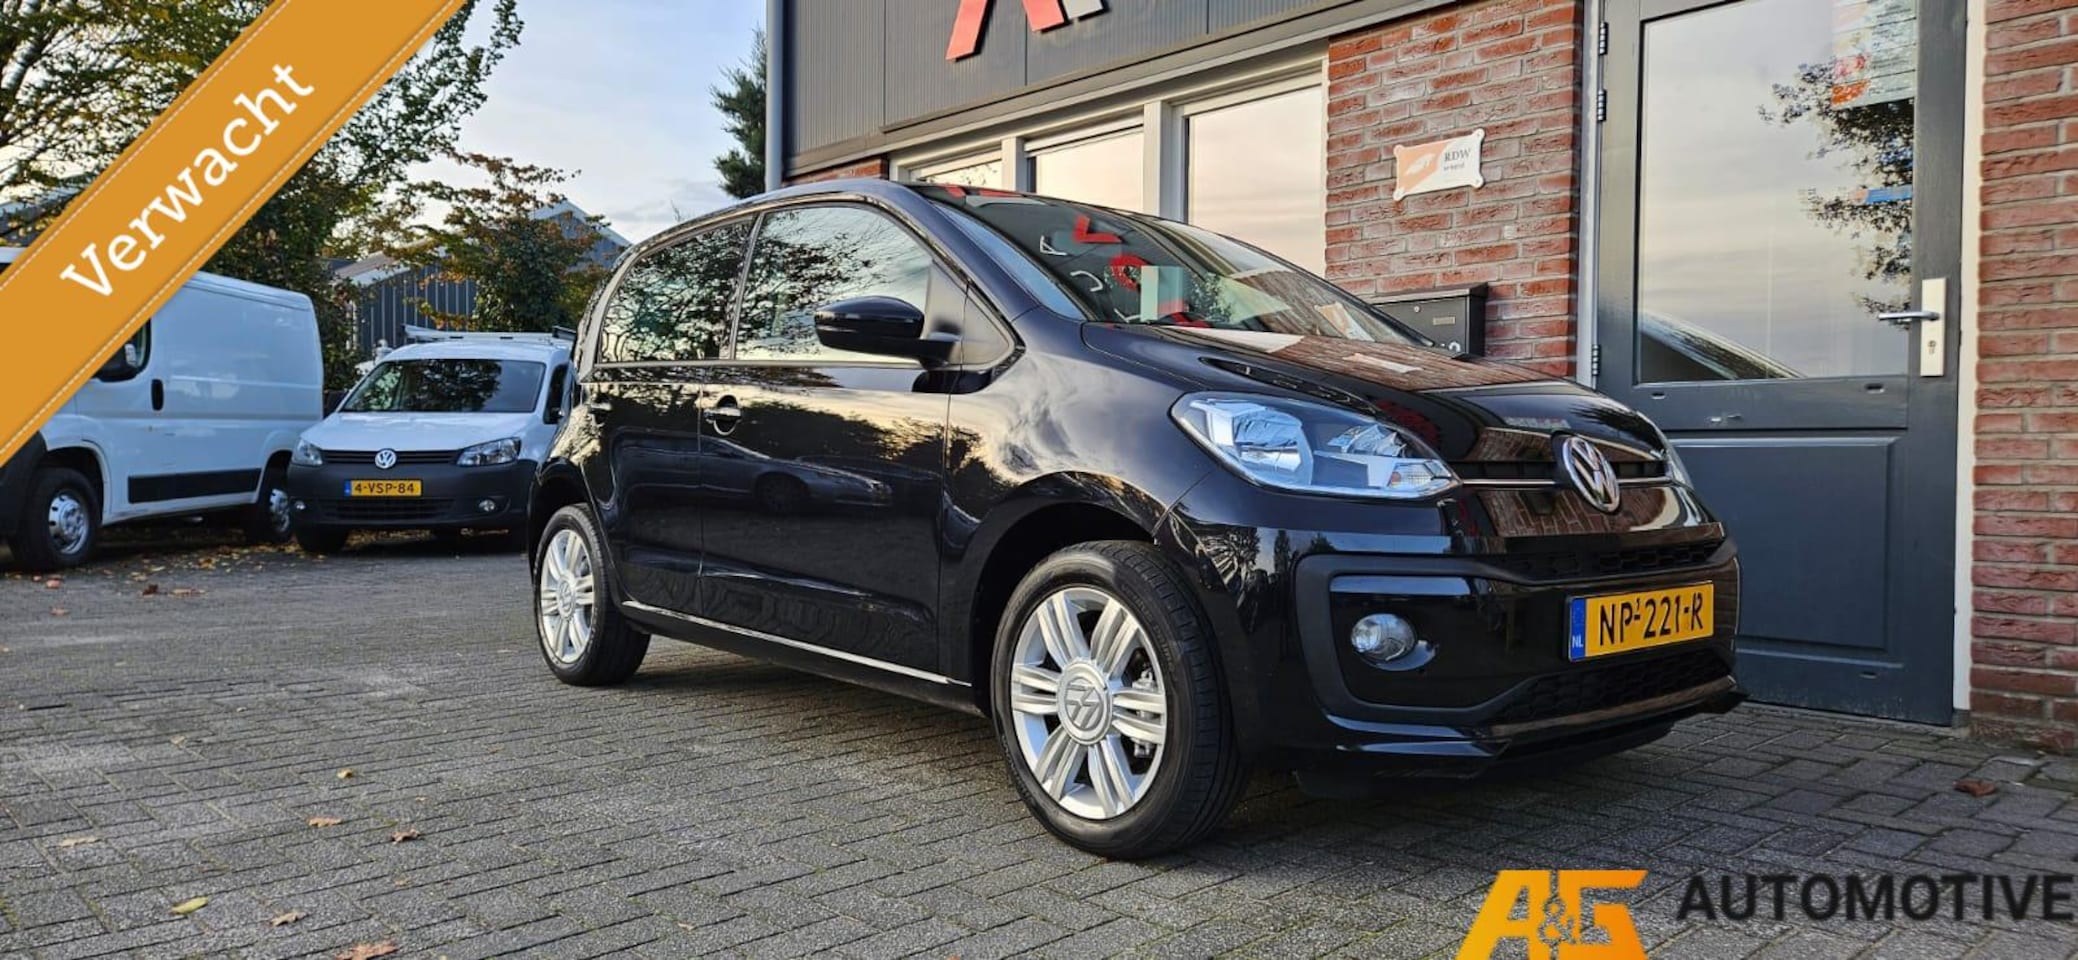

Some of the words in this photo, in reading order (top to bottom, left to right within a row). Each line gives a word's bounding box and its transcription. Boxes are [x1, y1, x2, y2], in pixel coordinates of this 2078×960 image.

[1444, 148, 1471, 161] RDW
[354, 483, 415, 494] 4-VSP-84
[1571, 635, 1584, 649] NL
